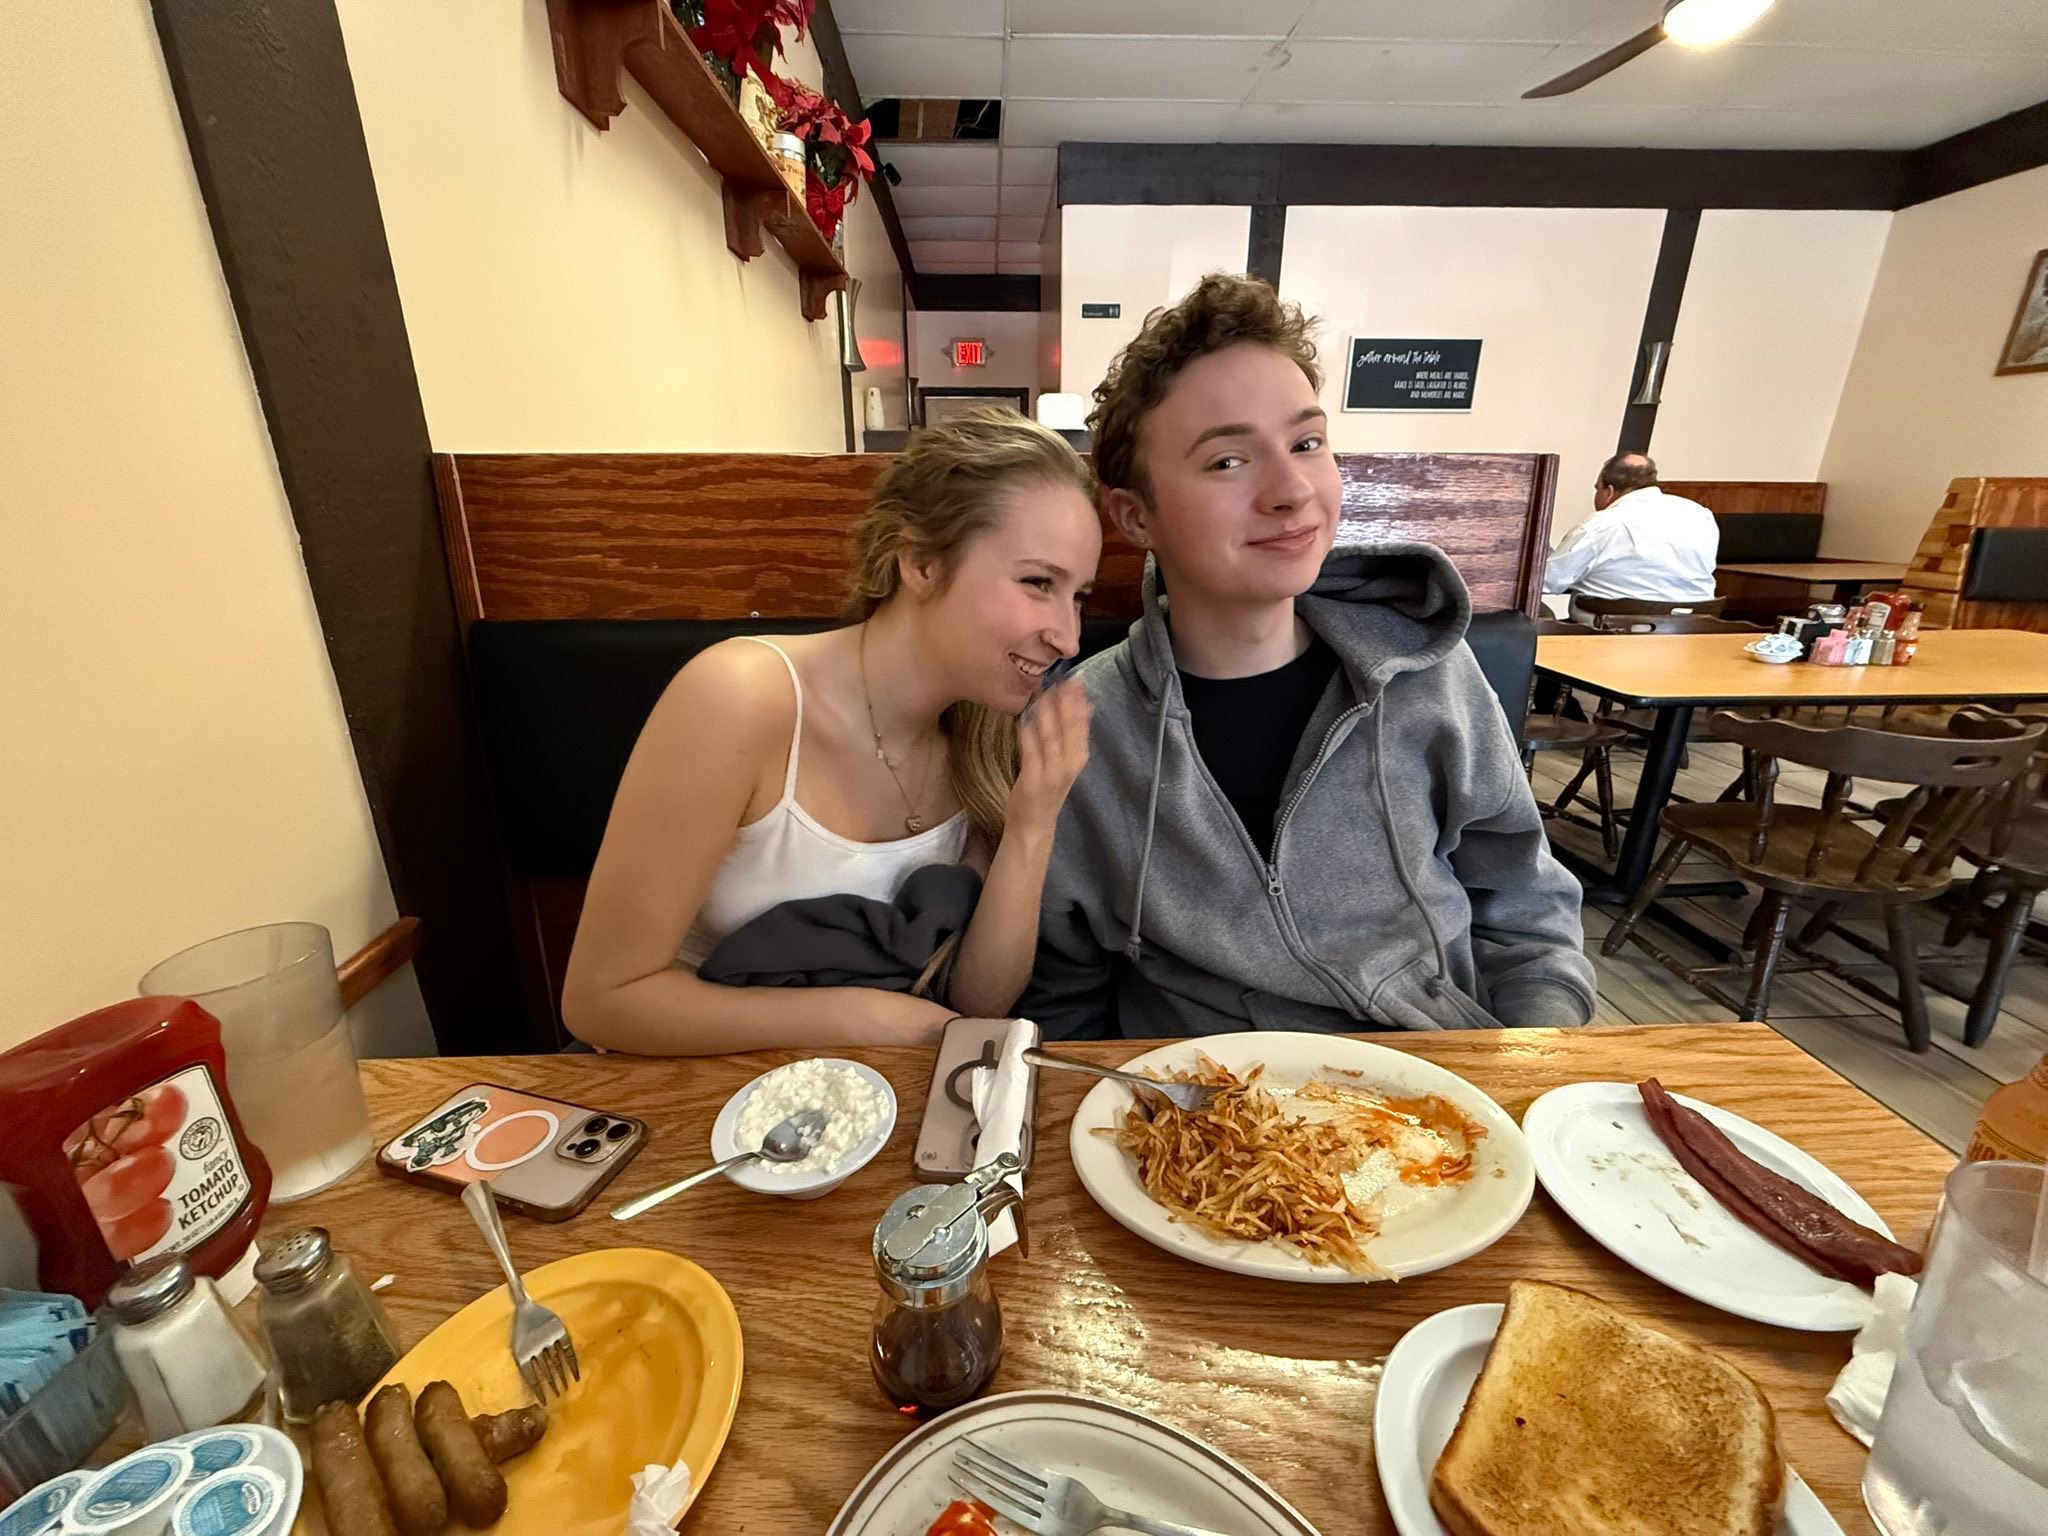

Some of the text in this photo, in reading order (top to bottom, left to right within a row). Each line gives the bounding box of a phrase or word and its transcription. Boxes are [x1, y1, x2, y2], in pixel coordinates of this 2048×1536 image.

[958, 342, 982, 364] EXIT
[1356, 350, 1382, 367] gather
[1383, 350, 1412, 365] around
[203, 1148, 229, 1175] fancy
[178, 1159, 235, 1209] TOMATO
[178, 1173, 239, 1230] KETCHUP
